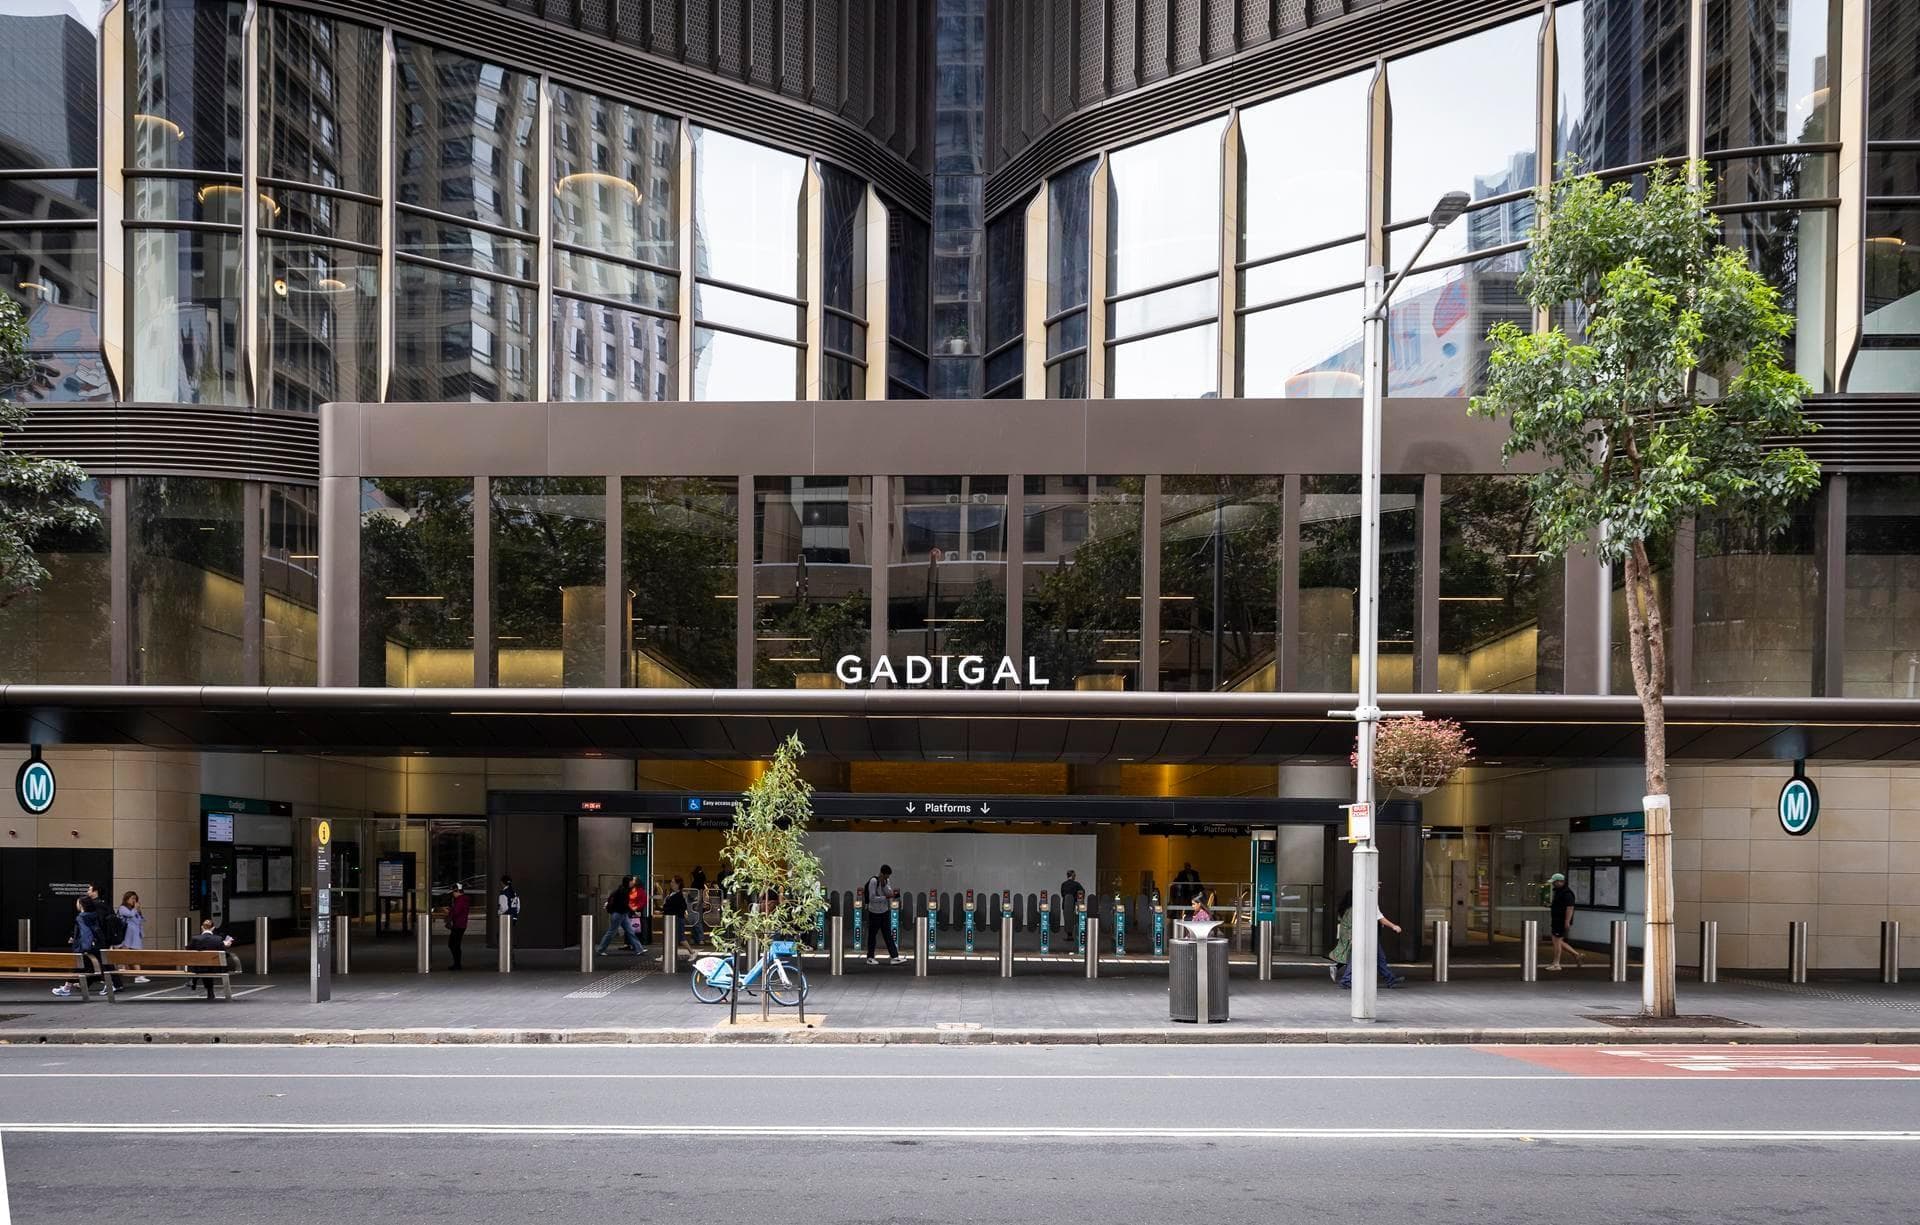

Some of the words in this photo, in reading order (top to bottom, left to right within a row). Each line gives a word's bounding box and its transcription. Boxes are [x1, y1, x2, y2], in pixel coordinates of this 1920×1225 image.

[836, 655, 1050, 684] GADIGAL
[30, 774, 47, 800] M
[925, 803, 971, 813] Platforms
[1787, 792, 1804, 820] M
[696, 819, 729, 828] Platforms
[1203, 825, 1238, 833] Platforms
